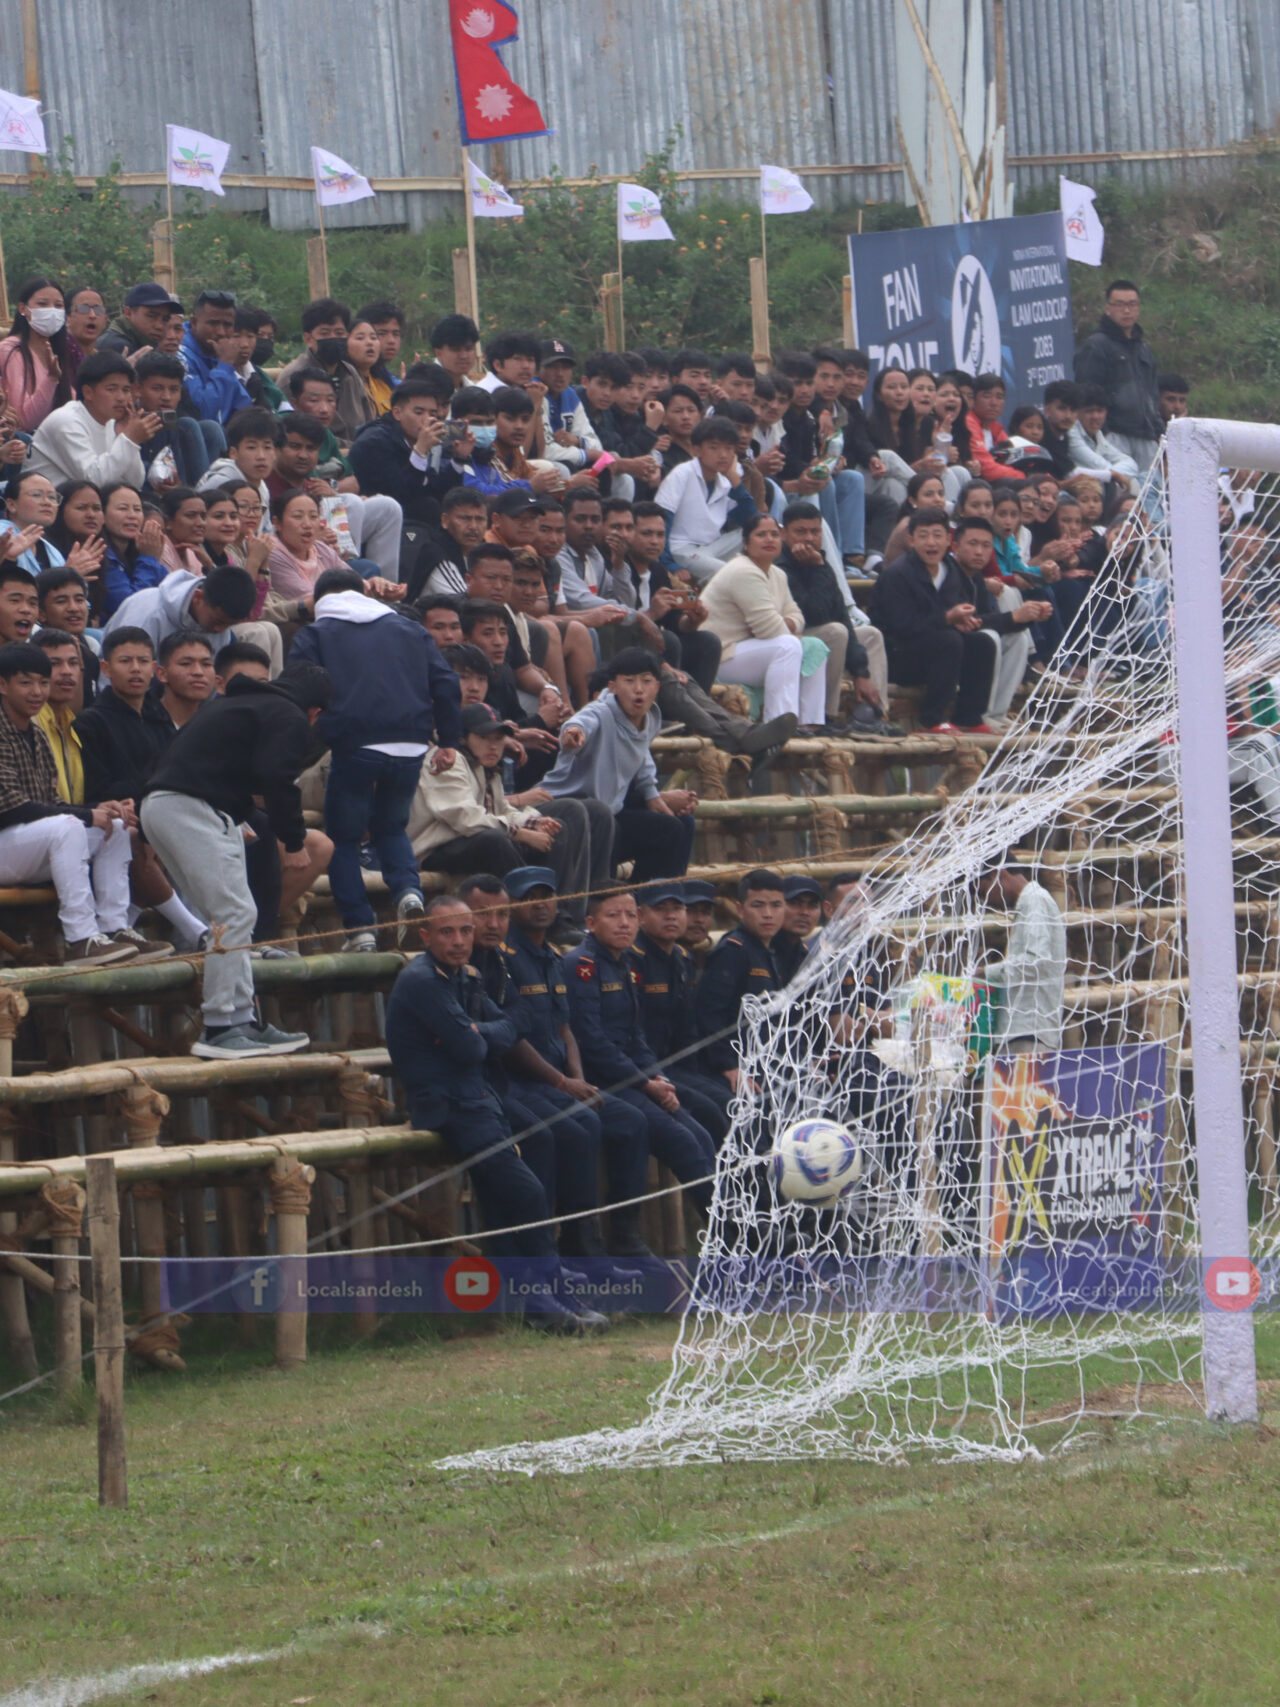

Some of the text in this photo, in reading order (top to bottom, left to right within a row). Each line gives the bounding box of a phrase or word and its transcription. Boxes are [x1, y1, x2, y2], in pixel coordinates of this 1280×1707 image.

[882, 264, 922, 330] FAN
[1009, 262, 1064, 292] INVITATIONAL
[1053, 1132, 1131, 1195] XTREME
